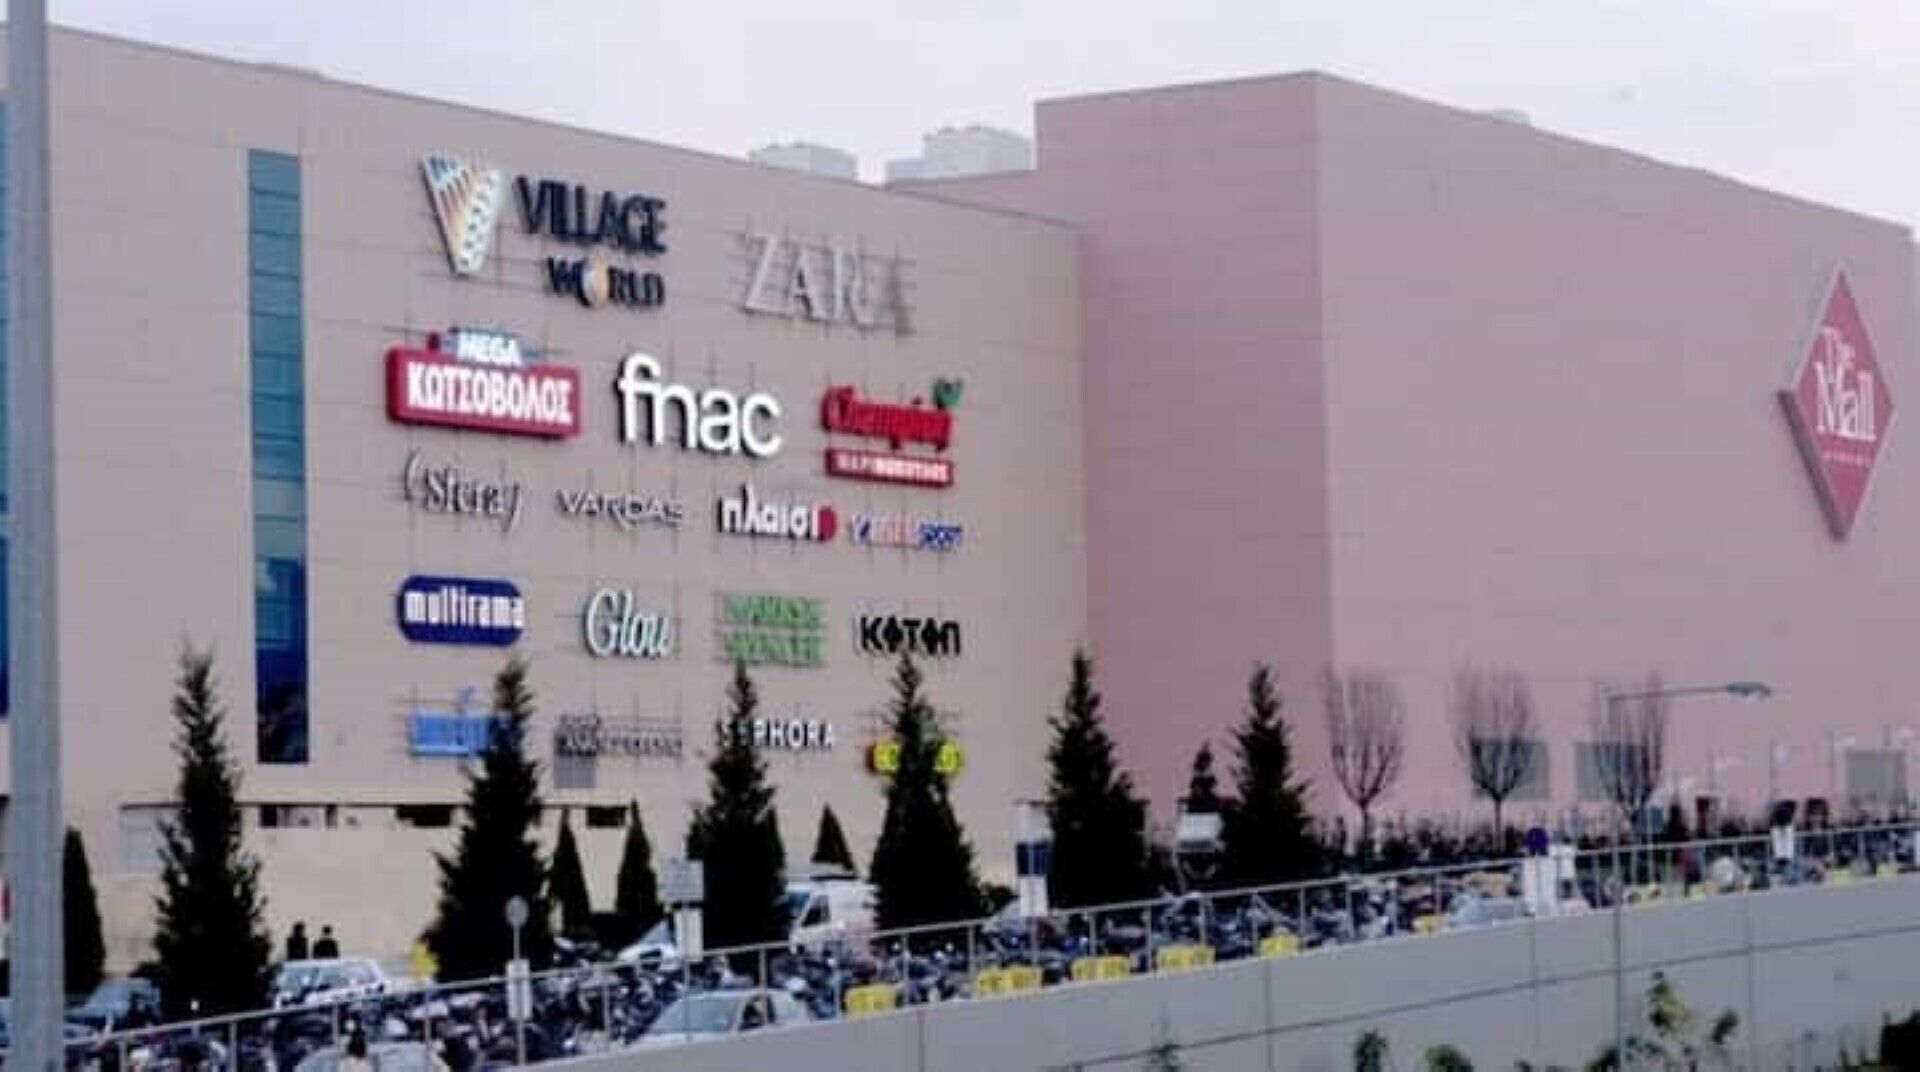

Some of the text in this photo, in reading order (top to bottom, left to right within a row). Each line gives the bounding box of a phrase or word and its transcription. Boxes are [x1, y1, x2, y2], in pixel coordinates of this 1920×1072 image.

[514, 174, 668, 255] VILLAGE
[546, 257, 666, 310] WORLD
[614, 352, 784, 459] fnac
[1813, 359, 1878, 443] Mall
[403, 585, 526, 630] multirama
